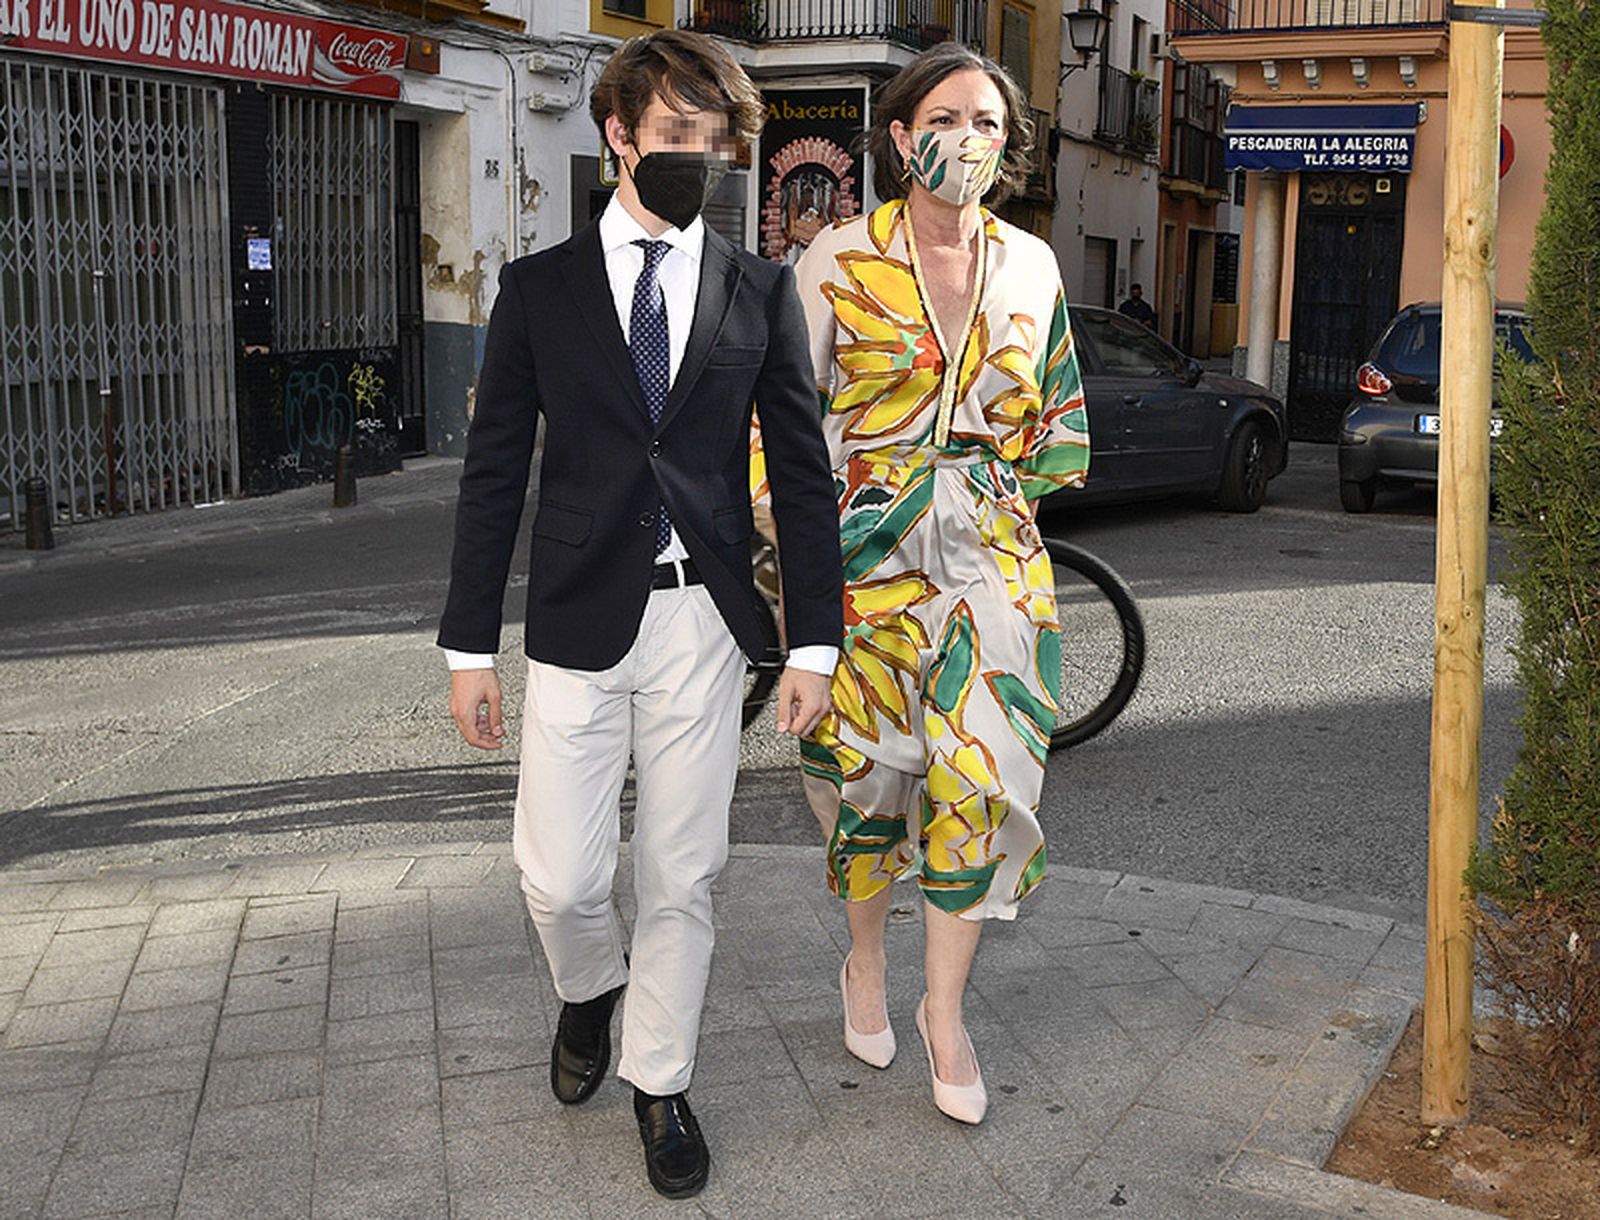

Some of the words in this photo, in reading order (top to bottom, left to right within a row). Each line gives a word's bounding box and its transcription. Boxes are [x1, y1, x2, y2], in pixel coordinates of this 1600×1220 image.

[37, 0, 71, 43] EL
[79, 0, 135, 52] UNO
[139, 1, 174, 58] DE
[178, 7, 229, 64] SAN
[230, 16, 312, 76] ROMAN
[767, 99, 859, 120] Abacería
[1229, 137, 1318, 151] PESCADERIA
[1322, 137, 1340, 151] LA
[1344, 137, 1409, 151] ALEGRIA
[1303, 153, 1329, 165] TLF.
[1332, 153, 1355, 165] 954
[1385, 153, 1409, 165] 738
